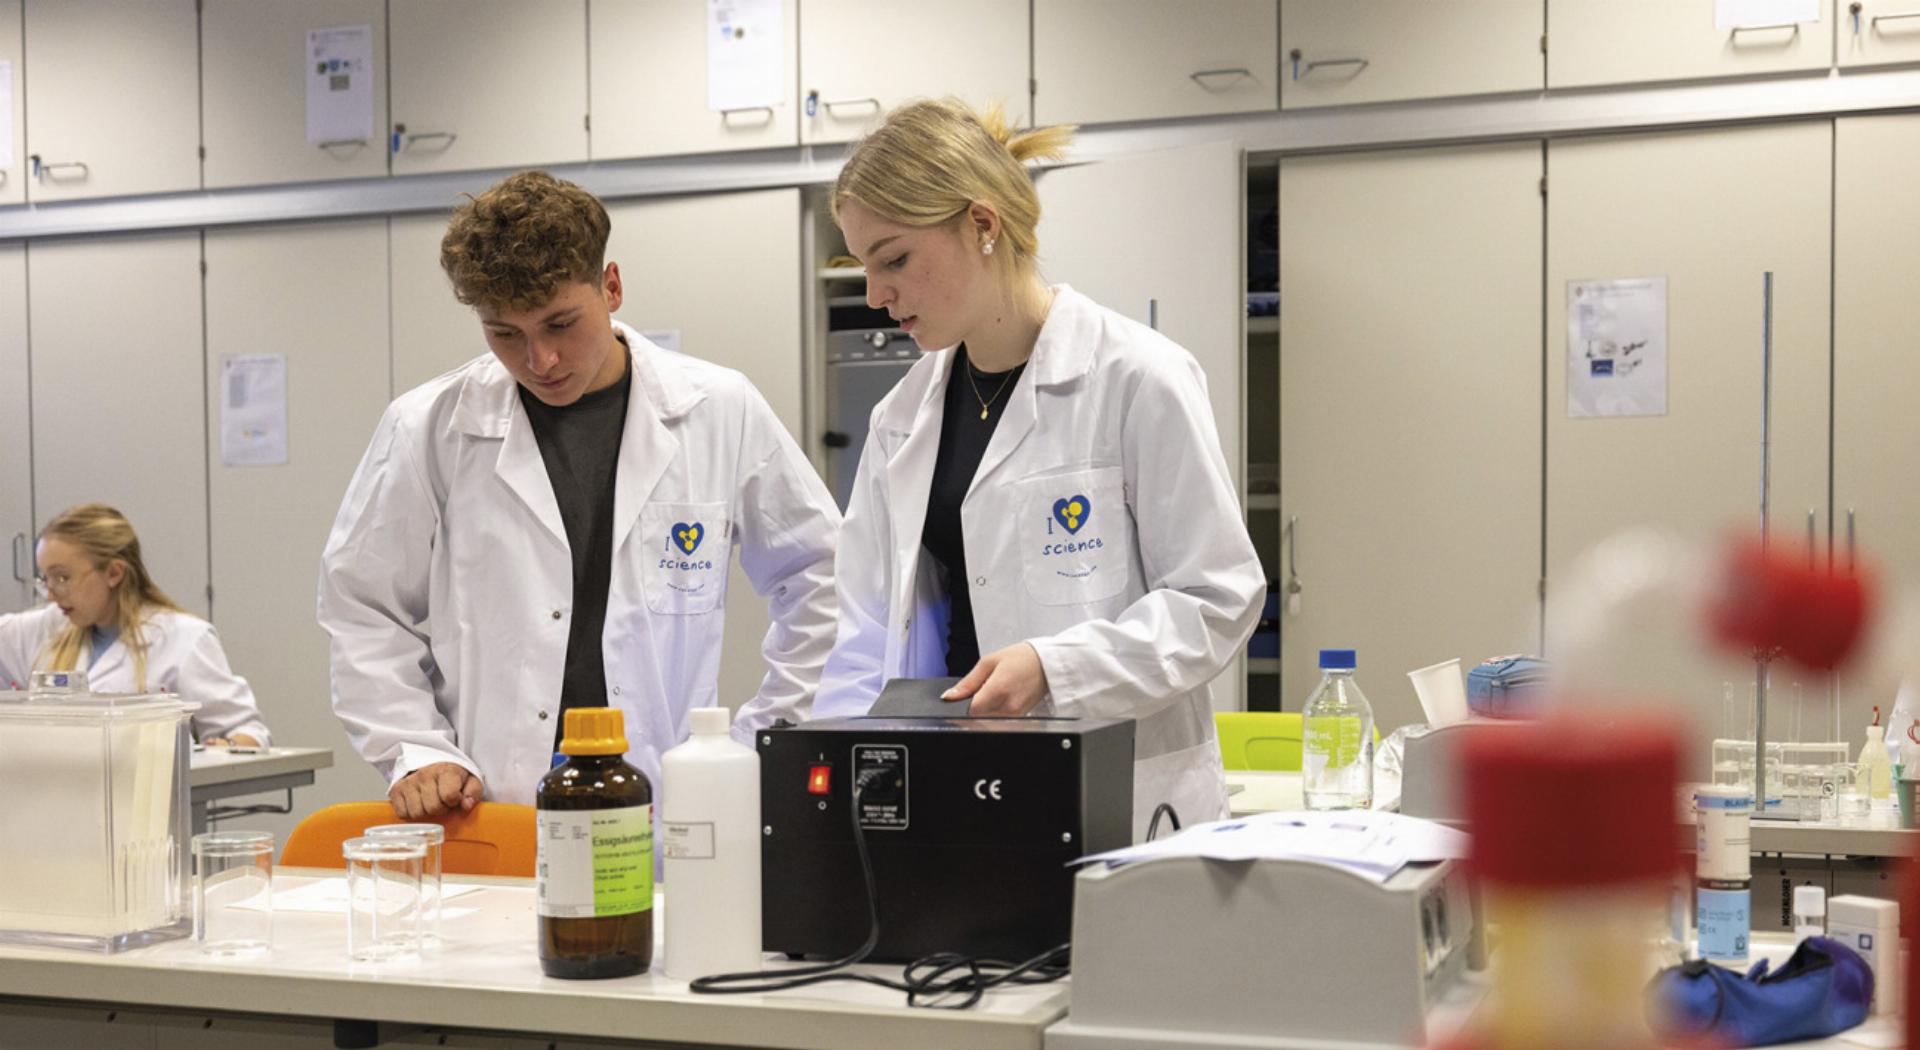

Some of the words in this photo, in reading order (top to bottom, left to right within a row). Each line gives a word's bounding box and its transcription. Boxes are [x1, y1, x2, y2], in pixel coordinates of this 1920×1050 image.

[1046, 516, 1054, 535] I
[665, 535, 671, 552] I
[1042, 538, 1104, 556] science
[658, 557, 713, 571] science
[974, 778, 1003, 801] CE
